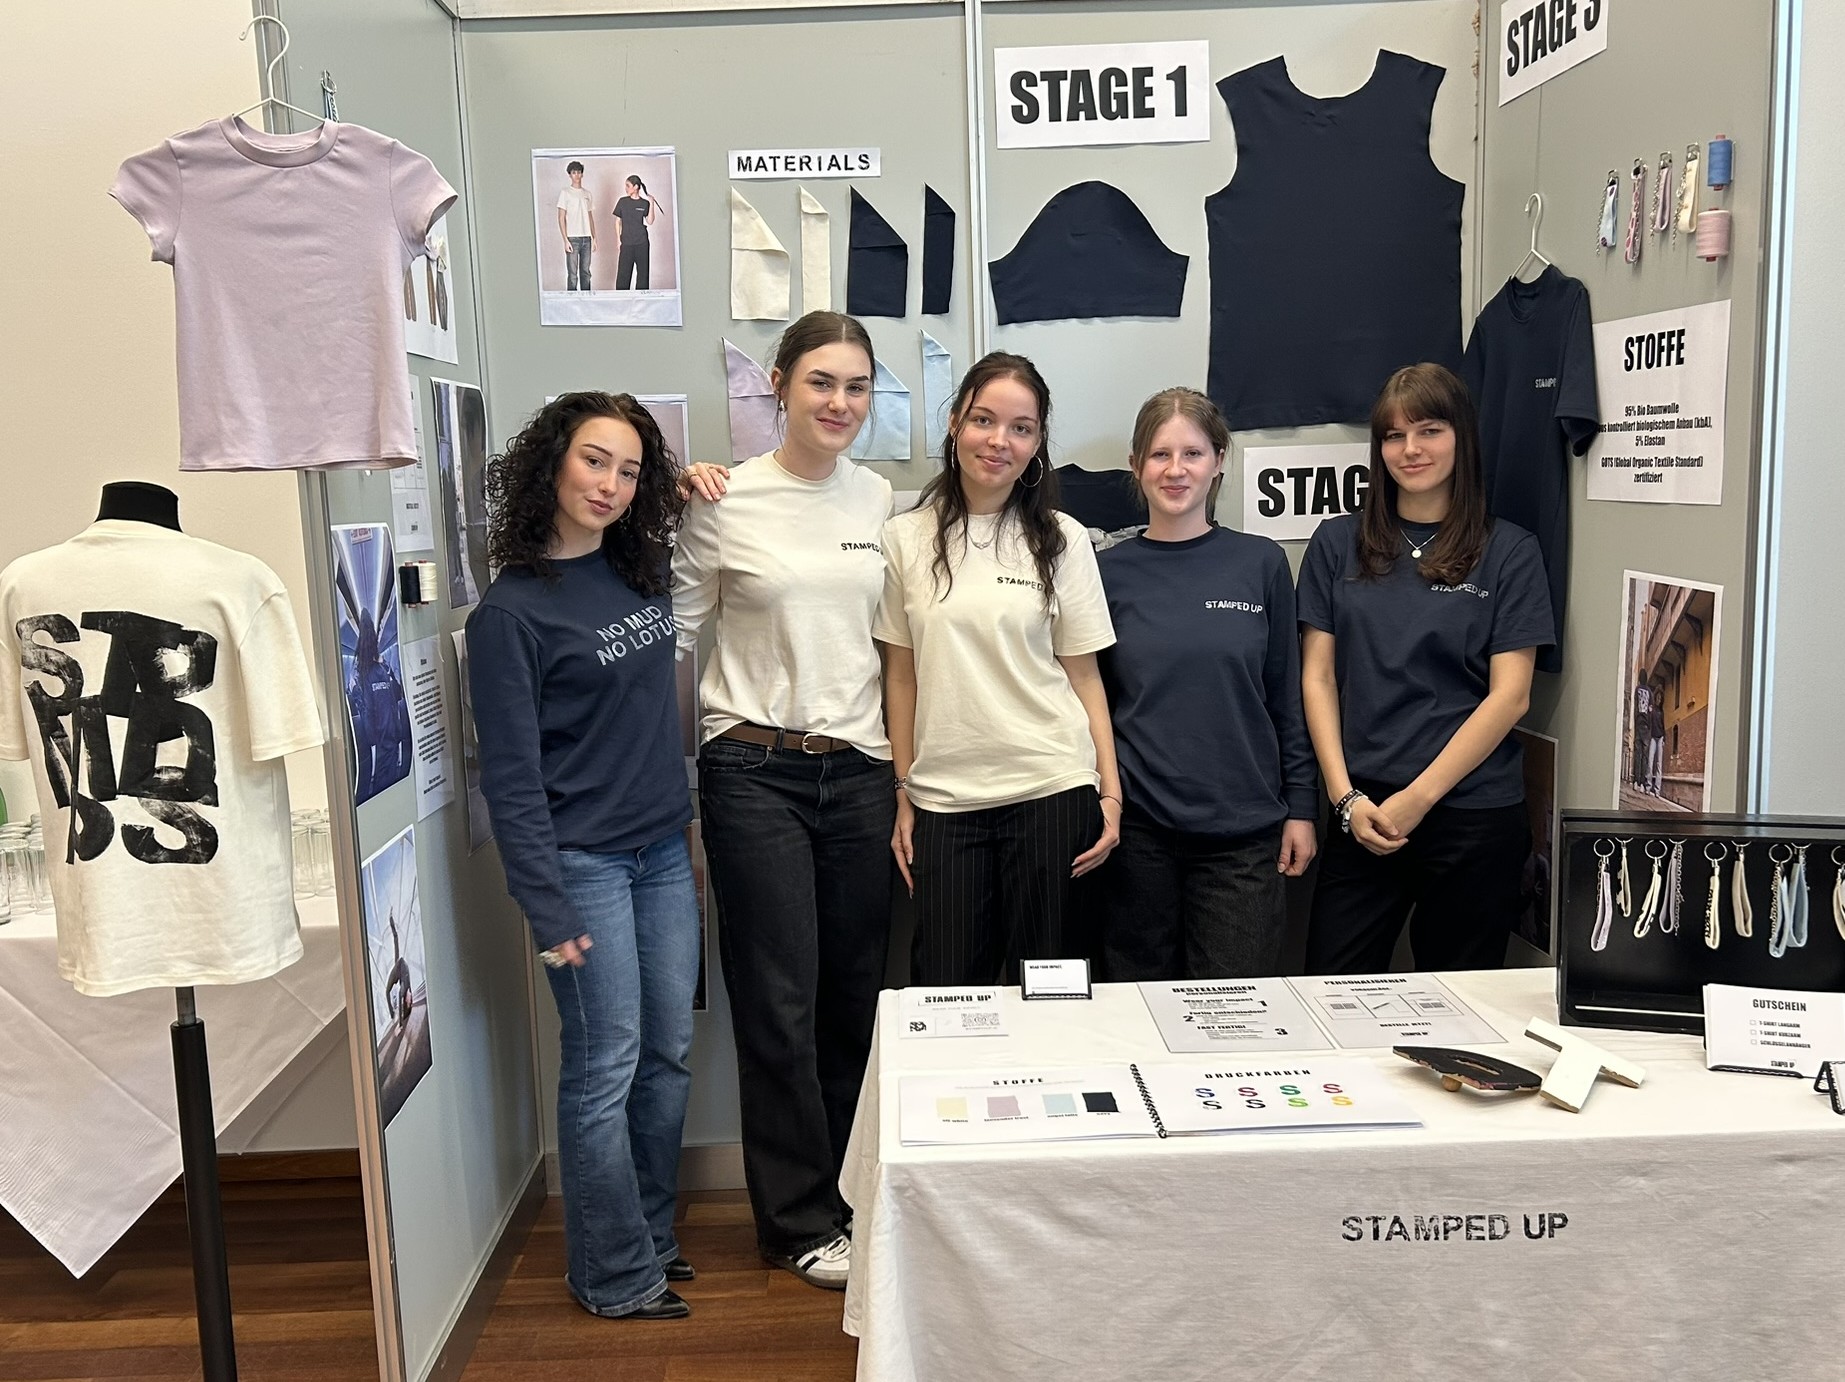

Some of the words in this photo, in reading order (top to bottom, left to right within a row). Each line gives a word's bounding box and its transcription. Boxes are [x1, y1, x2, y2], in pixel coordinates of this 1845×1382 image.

[1507, 0, 1577, 77] STAGE
[1010, 66, 1156, 124] STAGE
[1166, 65, 1187, 117] 1
[737, 154, 870, 172] MATERIALS
[1624, 328, 1685, 372] STOFFE
[1637, 404, 1646, 417] Bio
[1646, 402, 1679, 416] Baumwolle
[1607, 420, 1635, 432] kontrolliert
[1636, 418, 1675, 432] biologischem
[1676, 417, 1693, 429] Anbau
[1644, 435, 1665, 446] Elastan
[1601, 456, 1613, 467] GOTS
[1632, 456, 1653, 468] Organic
[1655, 456, 1674, 467] Textile
[1675, 456, 1703, 467] Standard)
[1634, 471, 1662, 483] zertifiziert
[1258, 464, 1370, 517] STAG
[997, 576, 1043, 591] STAMPED
[1478, 588, 1489, 599] UP
[1205, 600, 1250, 611] STAMPED
[1251, 603, 1263, 613] UP
[596, 623, 626, 642] NO
[623, 605, 662, 631] MUD
[596, 641, 627, 666] NO
[1172, 985, 1257, 993] BESTELLUNGEN
[924, 994, 973, 1003] STAMPED
[1753, 998, 1807, 1012] GUTSCHEIN
[1183, 1015, 1195, 1023] 2
[1275, 1027, 1289, 1036] 3
[1205, 1069, 1311, 1079] DRUCKFARBEN
[993, 1078, 1044, 1086] STOFFE
[1342, 1214, 1511, 1242] STAMPED
[1523, 1212, 1569, 1240] UP
